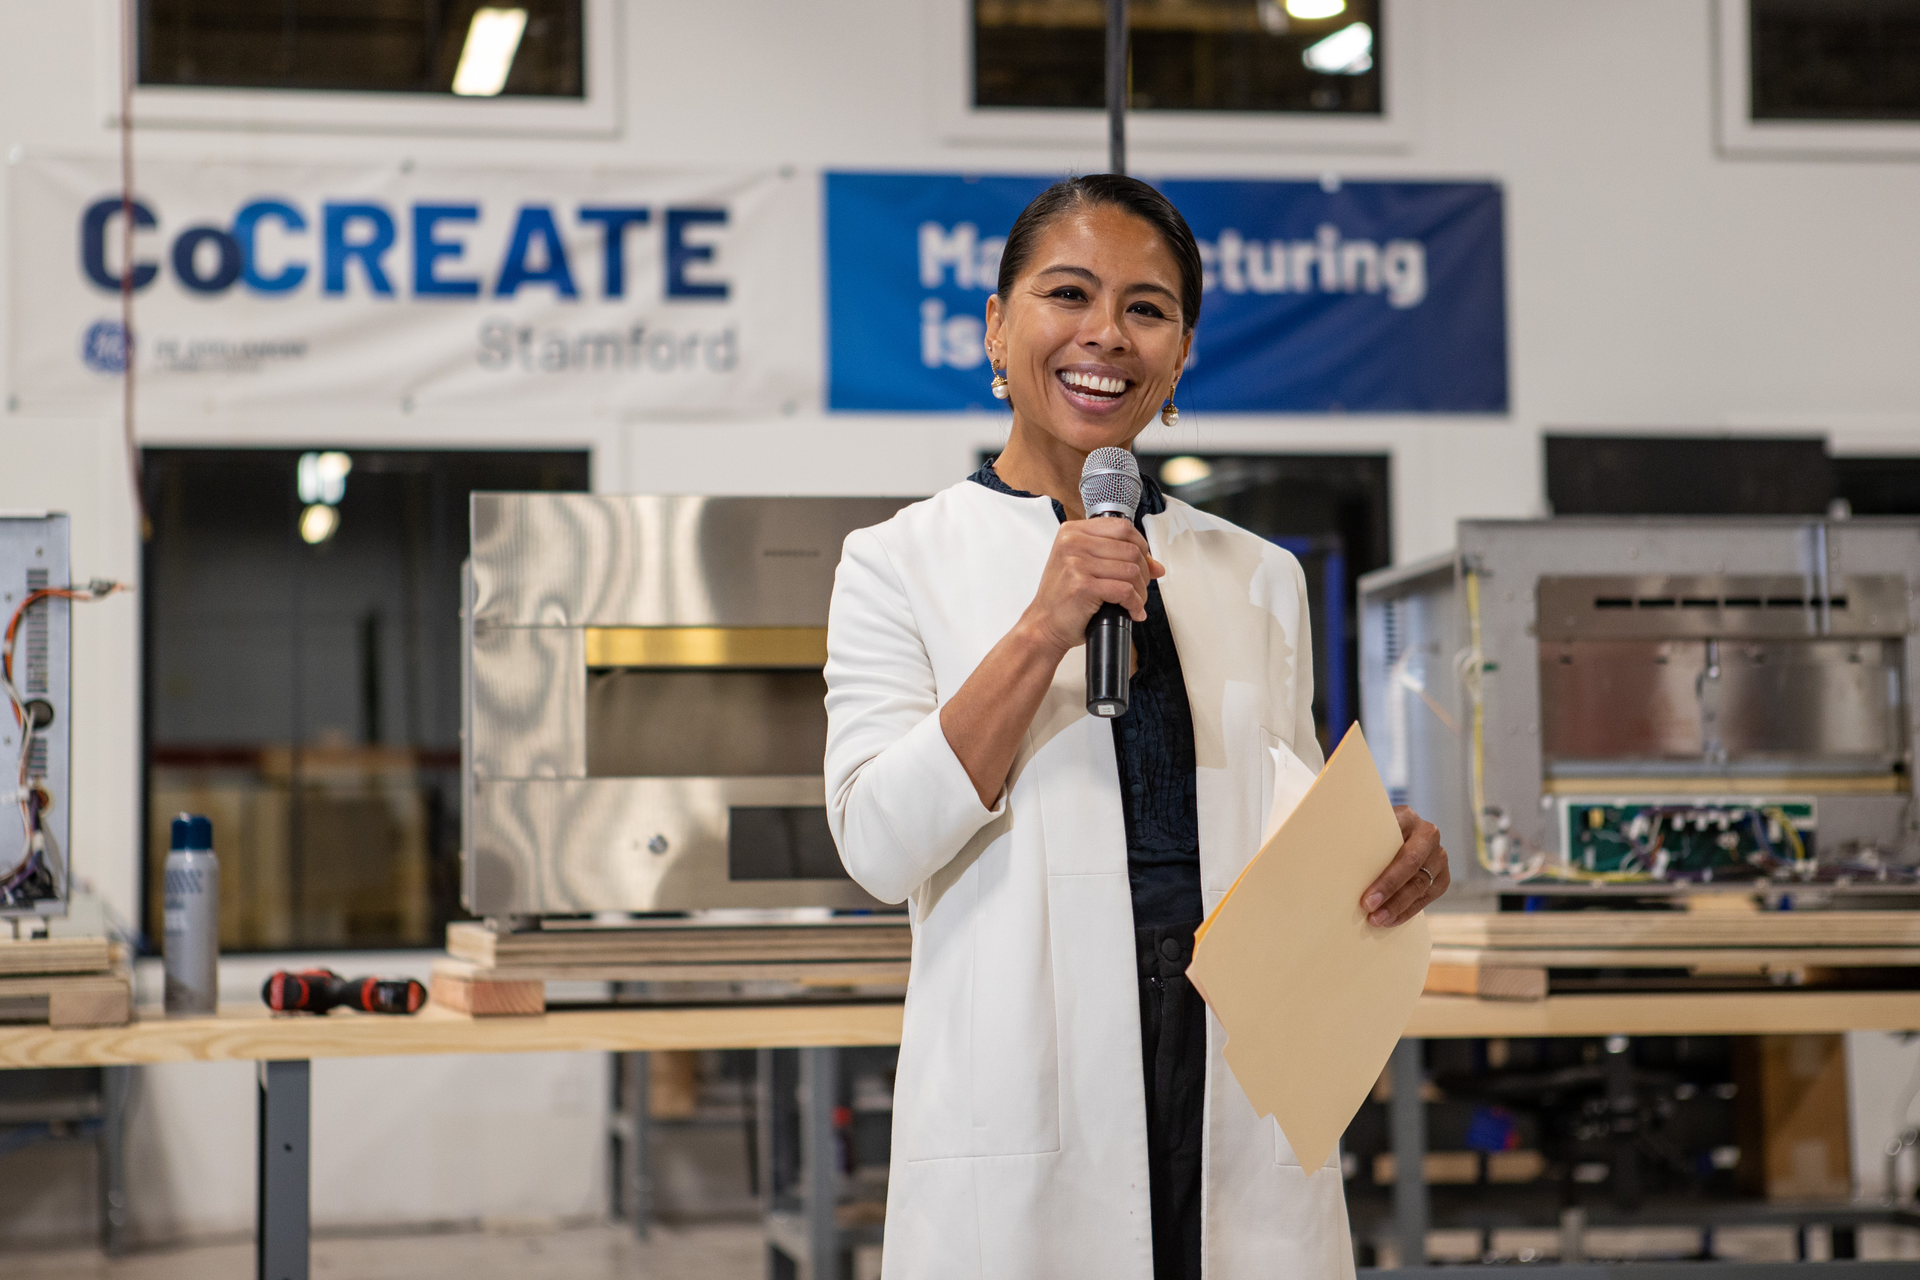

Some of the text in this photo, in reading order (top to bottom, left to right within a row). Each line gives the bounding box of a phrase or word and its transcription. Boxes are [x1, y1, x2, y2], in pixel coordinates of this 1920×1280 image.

[80, 197, 730, 301] CoCREATE
[917, 221, 1427, 309] Maturing
[477, 317, 739, 374] Stamford
[920, 299, 986, 369] is
